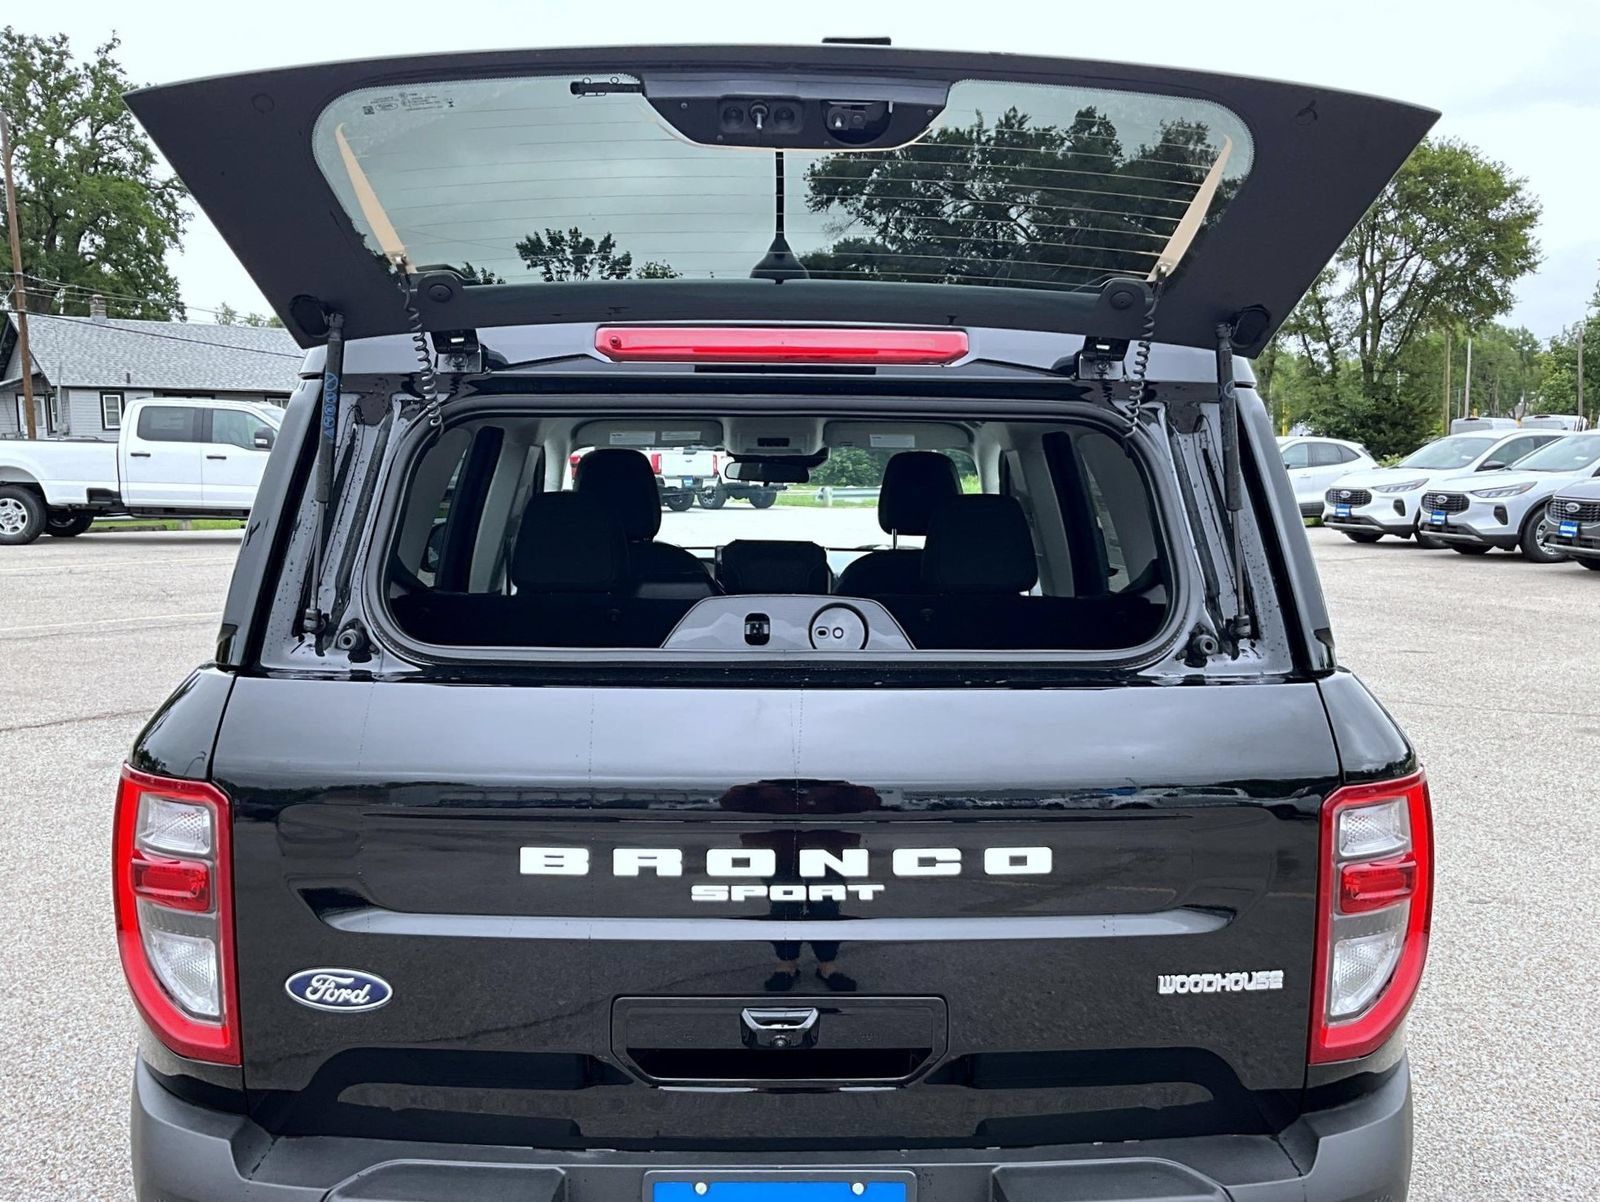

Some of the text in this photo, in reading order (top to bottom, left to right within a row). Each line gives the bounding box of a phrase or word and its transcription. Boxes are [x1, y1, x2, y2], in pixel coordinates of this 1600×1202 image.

[520, 846, 1053, 877] BRONCO
[690, 884, 886, 902] SPORT
[305, 974, 371, 1004] Ford
[1157, 969, 1284, 994] WOODHOUSE
